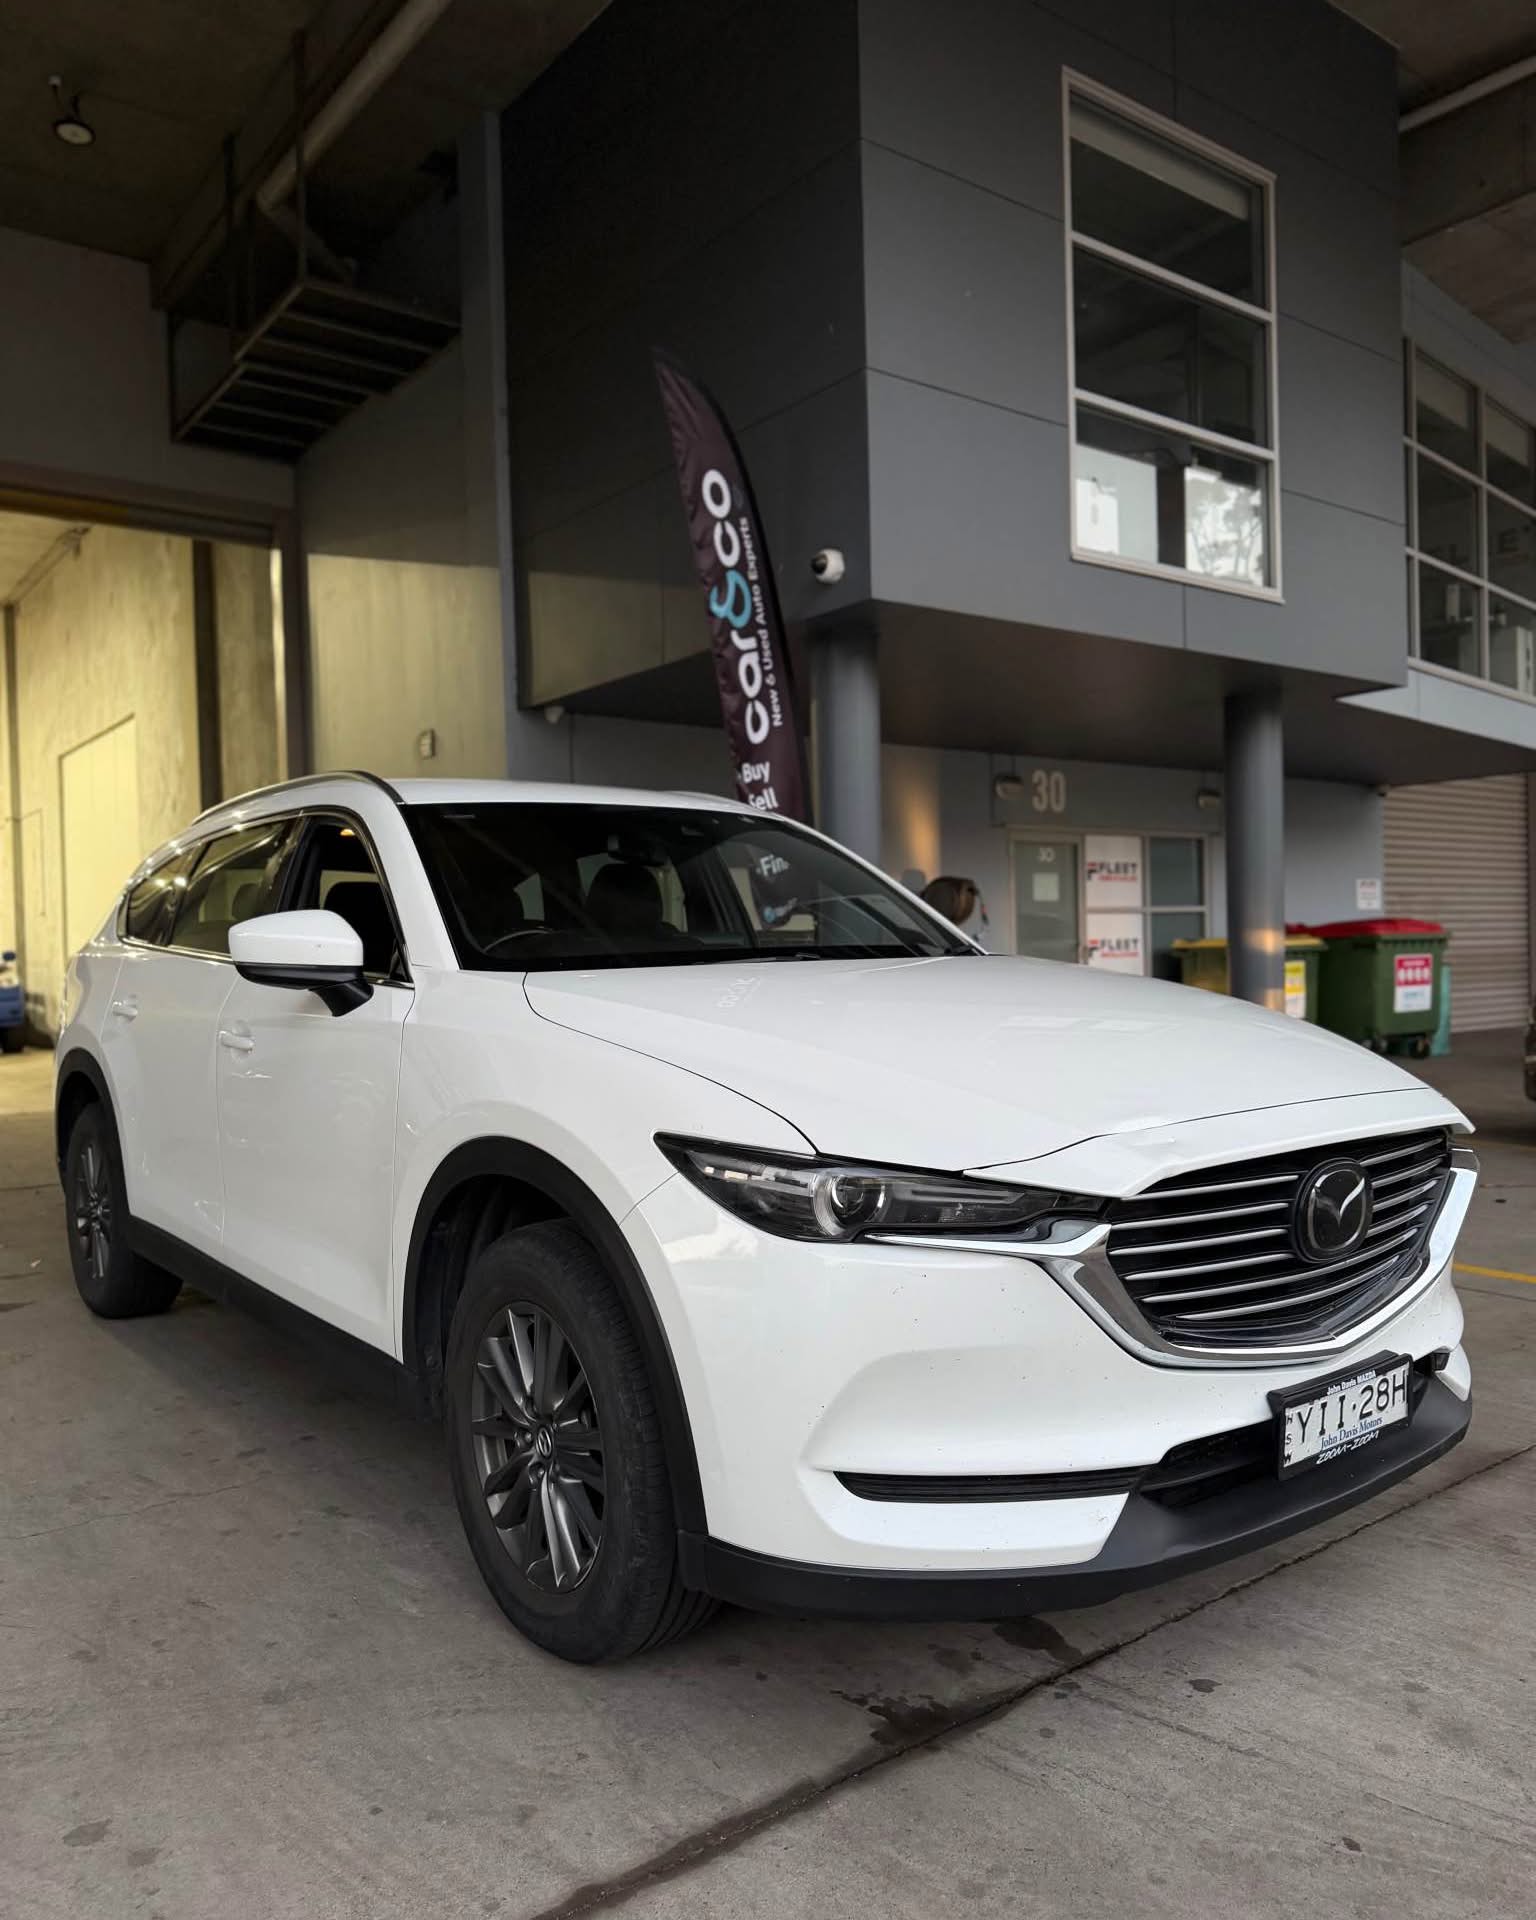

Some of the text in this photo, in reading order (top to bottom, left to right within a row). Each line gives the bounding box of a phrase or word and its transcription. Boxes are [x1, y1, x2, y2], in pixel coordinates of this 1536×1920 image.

[752, 584, 766, 625] Auto
[758, 629, 774, 671] Used
[769, 689, 783, 727] New
[741, 761, 771, 784] Buy
[1032, 770, 1066, 813] 30
[1327, 1385, 1341, 1395] John
[1341, 1380, 1356, 1390] Davis
[1321, 1417, 1383, 1449] John Davis Motors
